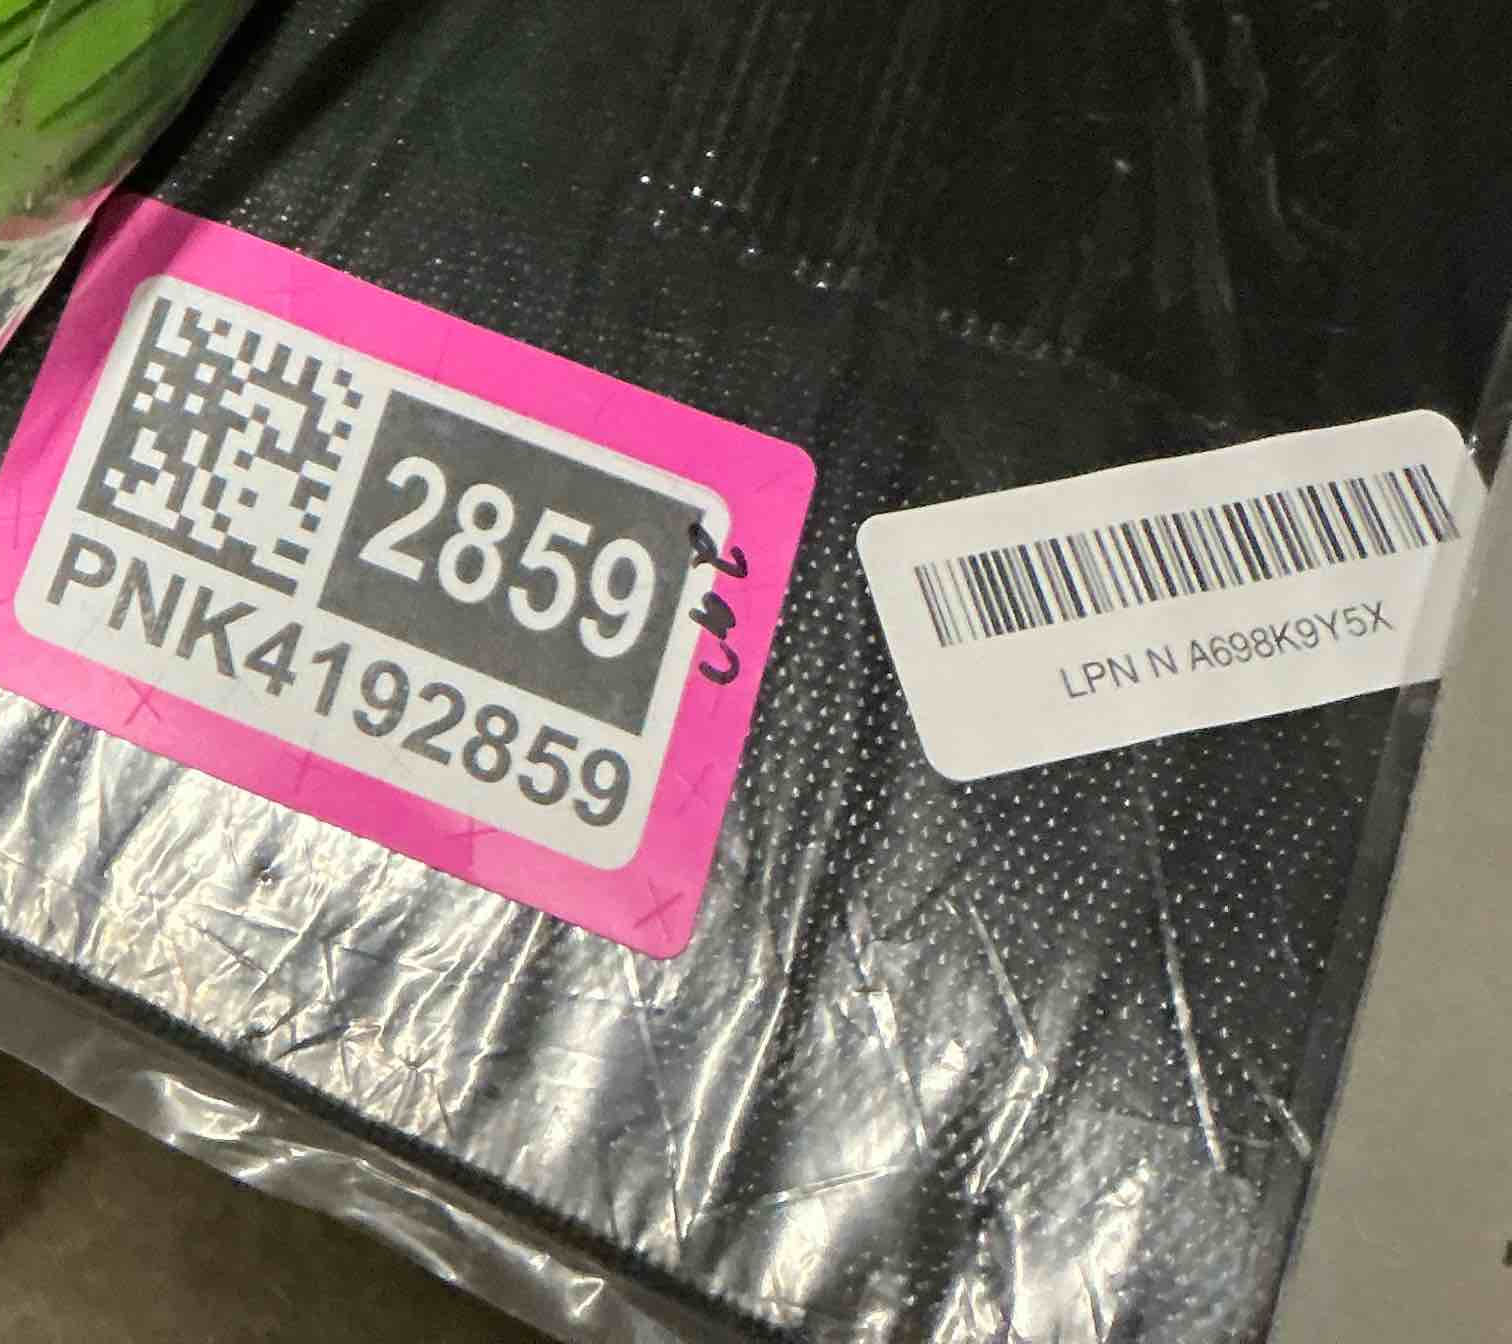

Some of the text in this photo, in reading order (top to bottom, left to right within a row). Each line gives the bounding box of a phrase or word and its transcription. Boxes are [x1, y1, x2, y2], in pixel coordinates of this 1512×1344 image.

[358, 455, 658, 661] 2859
[1058, 599, 1395, 701] LPN N A698K9Y5X
[46, 532, 632, 828] PNK4192859
